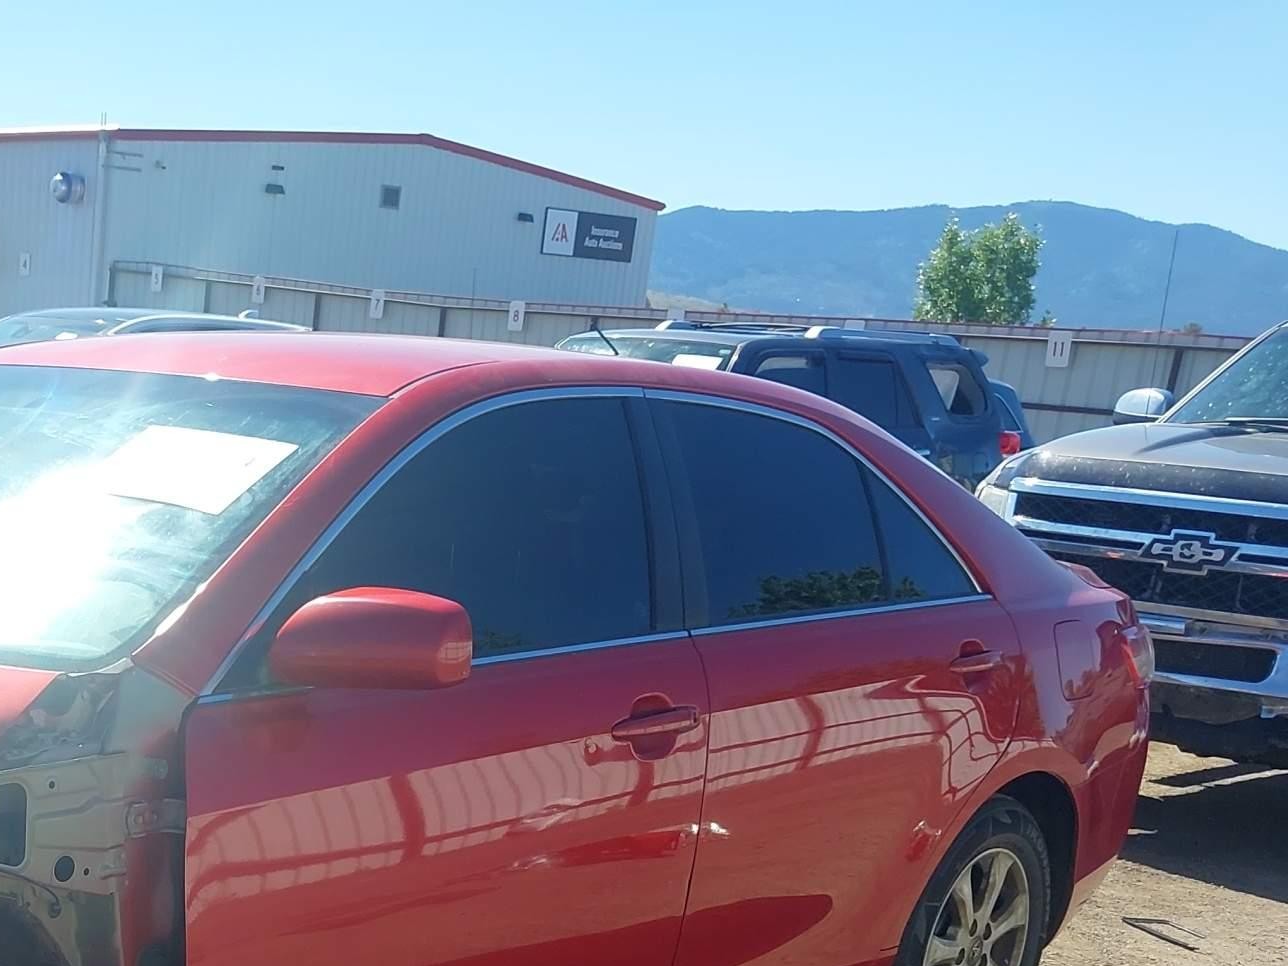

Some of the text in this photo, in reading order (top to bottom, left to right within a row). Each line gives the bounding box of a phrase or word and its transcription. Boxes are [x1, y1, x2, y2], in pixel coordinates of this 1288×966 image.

[584, 236, 598, 248] Auto
[374, 298, 381, 311] 7
[512, 309, 520, 323] 8
[1052, 341, 1065, 358] 11
